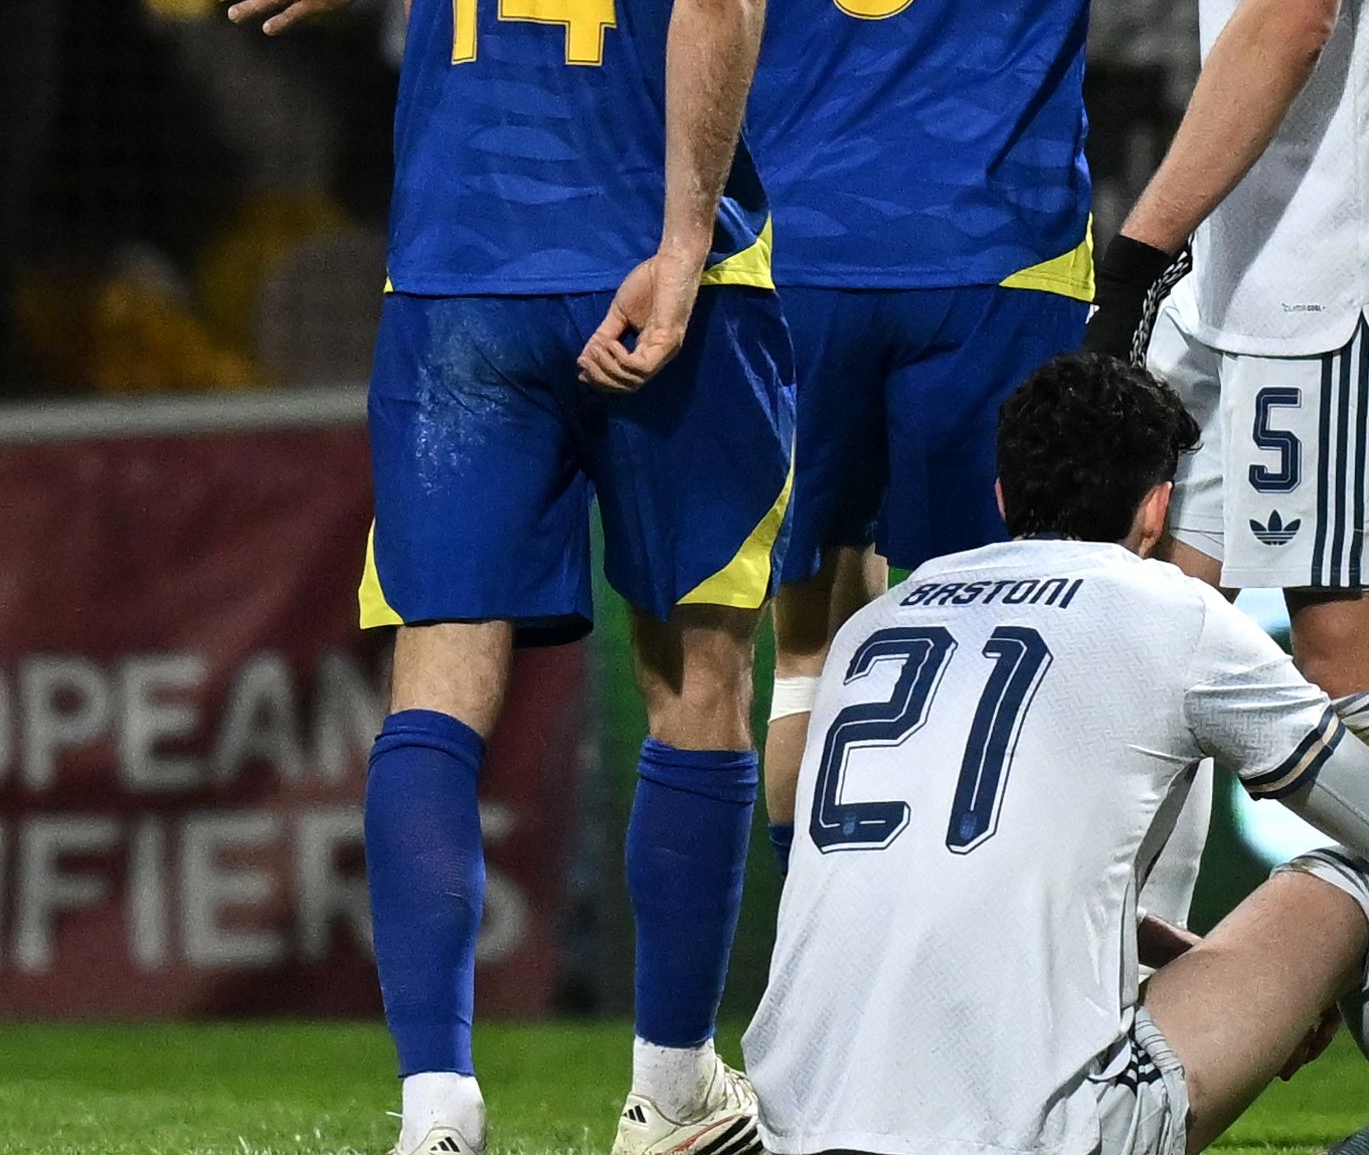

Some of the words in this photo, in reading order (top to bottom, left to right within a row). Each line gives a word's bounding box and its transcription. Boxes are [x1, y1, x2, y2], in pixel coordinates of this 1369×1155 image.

[1248, 387, 1302, 494] 5
[899, 578, 1085, 609] BASTONI
[808, 626, 1054, 855] 21
